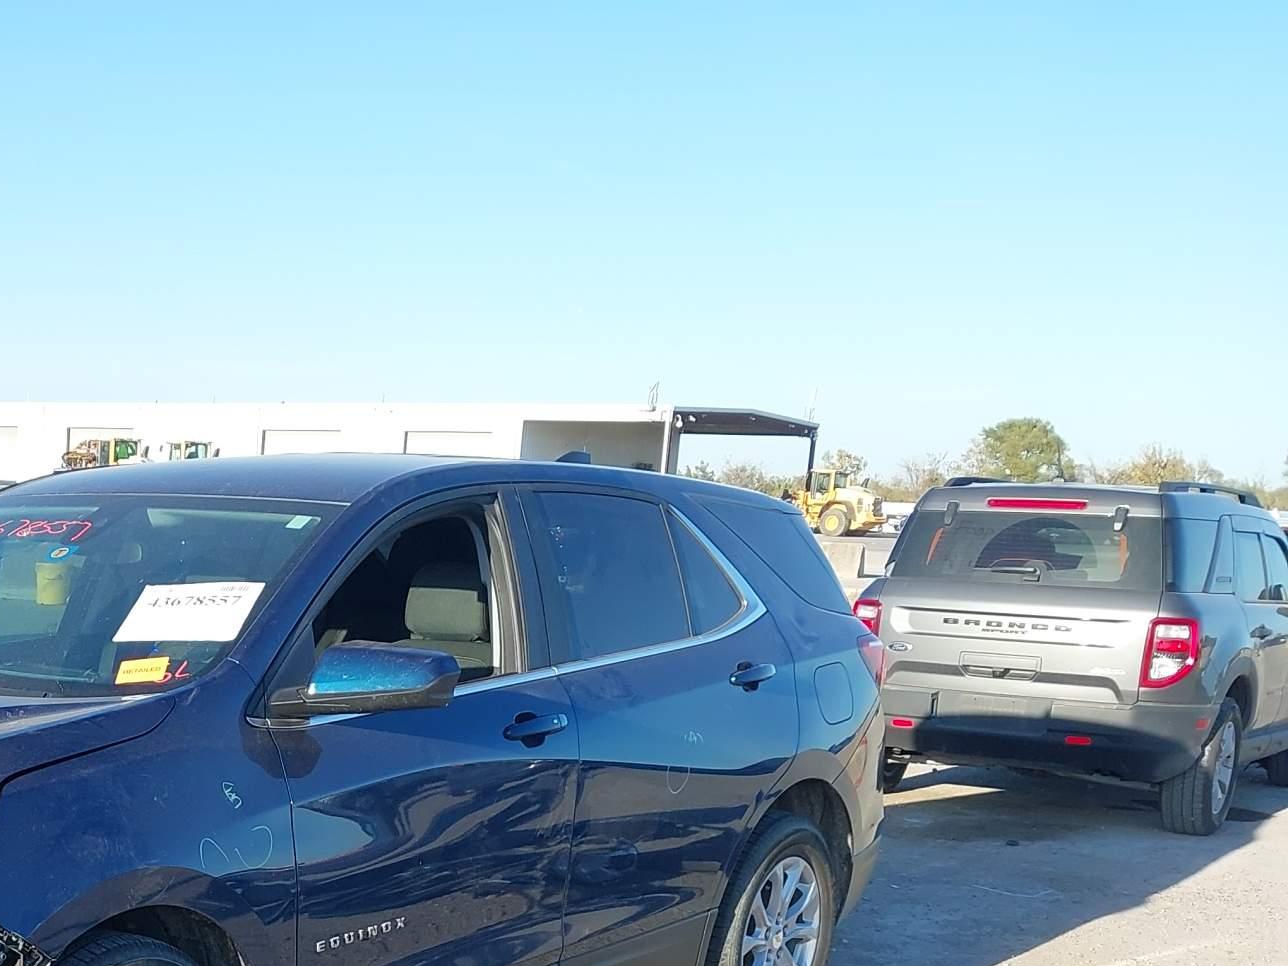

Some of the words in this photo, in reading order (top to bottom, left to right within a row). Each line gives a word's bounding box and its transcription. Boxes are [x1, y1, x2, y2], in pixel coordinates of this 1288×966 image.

[148, 595, 242, 608] 43678557
[942, 617, 1072, 632] BRONCO
[315, 915, 407, 954] EQUINOX
